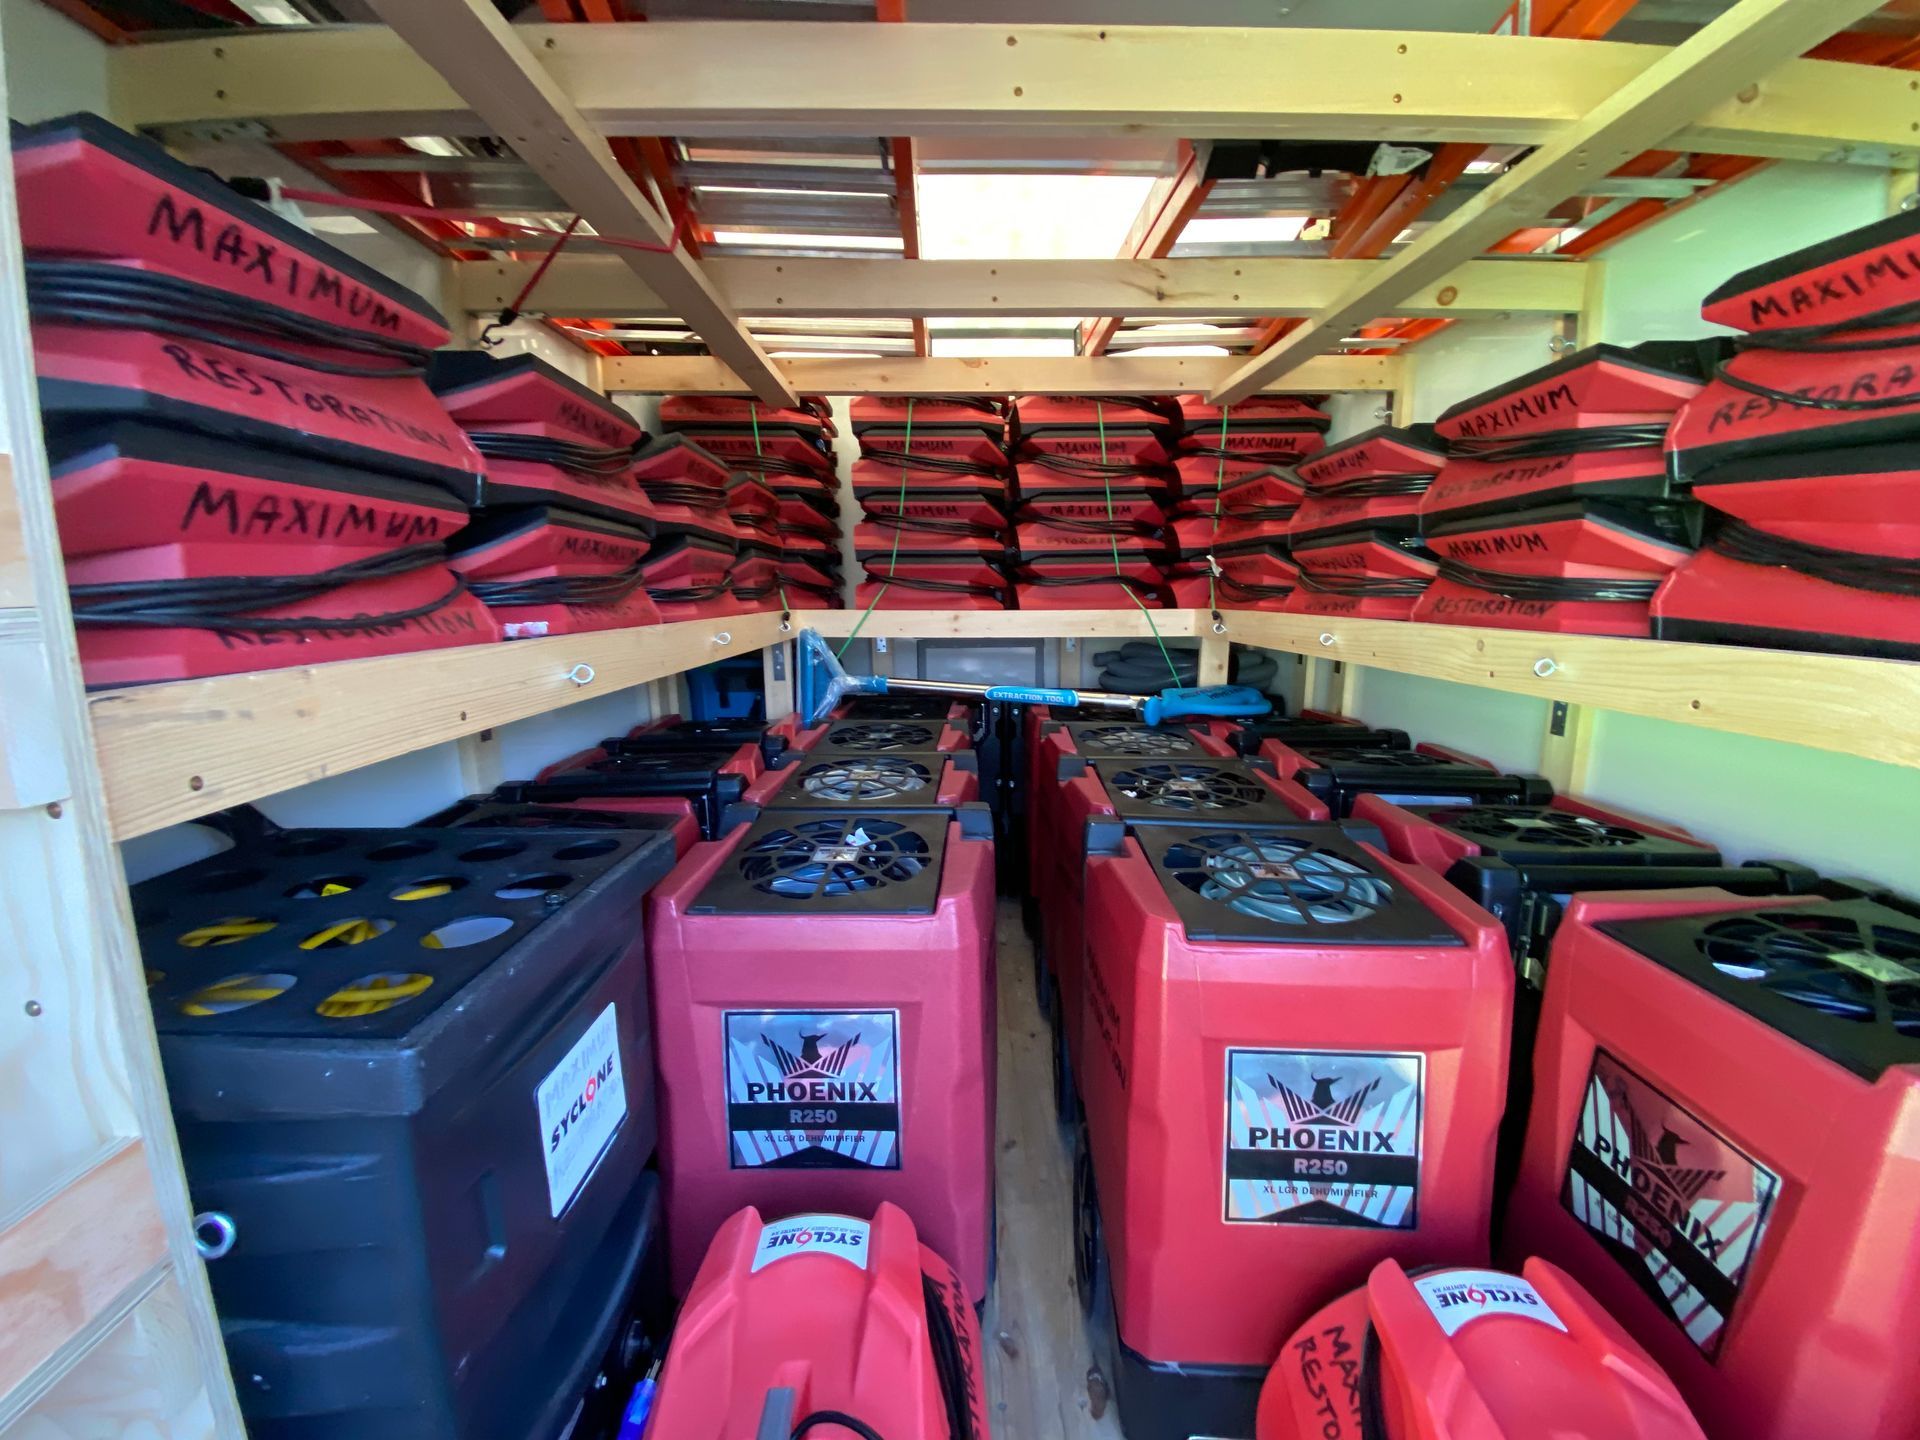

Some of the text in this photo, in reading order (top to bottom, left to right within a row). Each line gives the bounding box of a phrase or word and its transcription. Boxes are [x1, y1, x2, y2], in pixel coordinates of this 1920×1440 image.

[148, 192, 402, 332] MAXIMUM
[161, 343, 452, 451] RESTORATION
[1457, 383, 1579, 437] MAXIMUM
[886, 439, 954, 452] MAXIMUM
[1225, 436, 1297, 450] MAXIMUM
[180, 481, 439, 542] MAXIMUM
[880, 504, 960, 517] MAXIMUM
[1050, 504, 1133, 516] MAXIMUM
[1448, 532, 1550, 559] MAXIMUM
[1431, 597, 1556, 619] RESTORATION
[992, 690, 1065, 703] EXTRACTION TOOL
[550, 1050, 615, 1154] SYCLONE
[747, 1081, 878, 1102] PHOENIX
[789, 1109, 838, 1124] R250
[798, 1134, 866, 1144] DEHUMIDIFIER
[1248, 1126, 1396, 1153] PHOENIX
[1293, 1157, 1349, 1177] R250
[1263, 1185, 1379, 1199] XL LGR DEHUMIDIFIER
[1595, 1133, 1723, 1265] PHOENIX
[1624, 1194, 1673, 1250] R250
[766, 1228, 863, 1249] SYCLONE
[1435, 1286, 1539, 1309] SYCLONE
